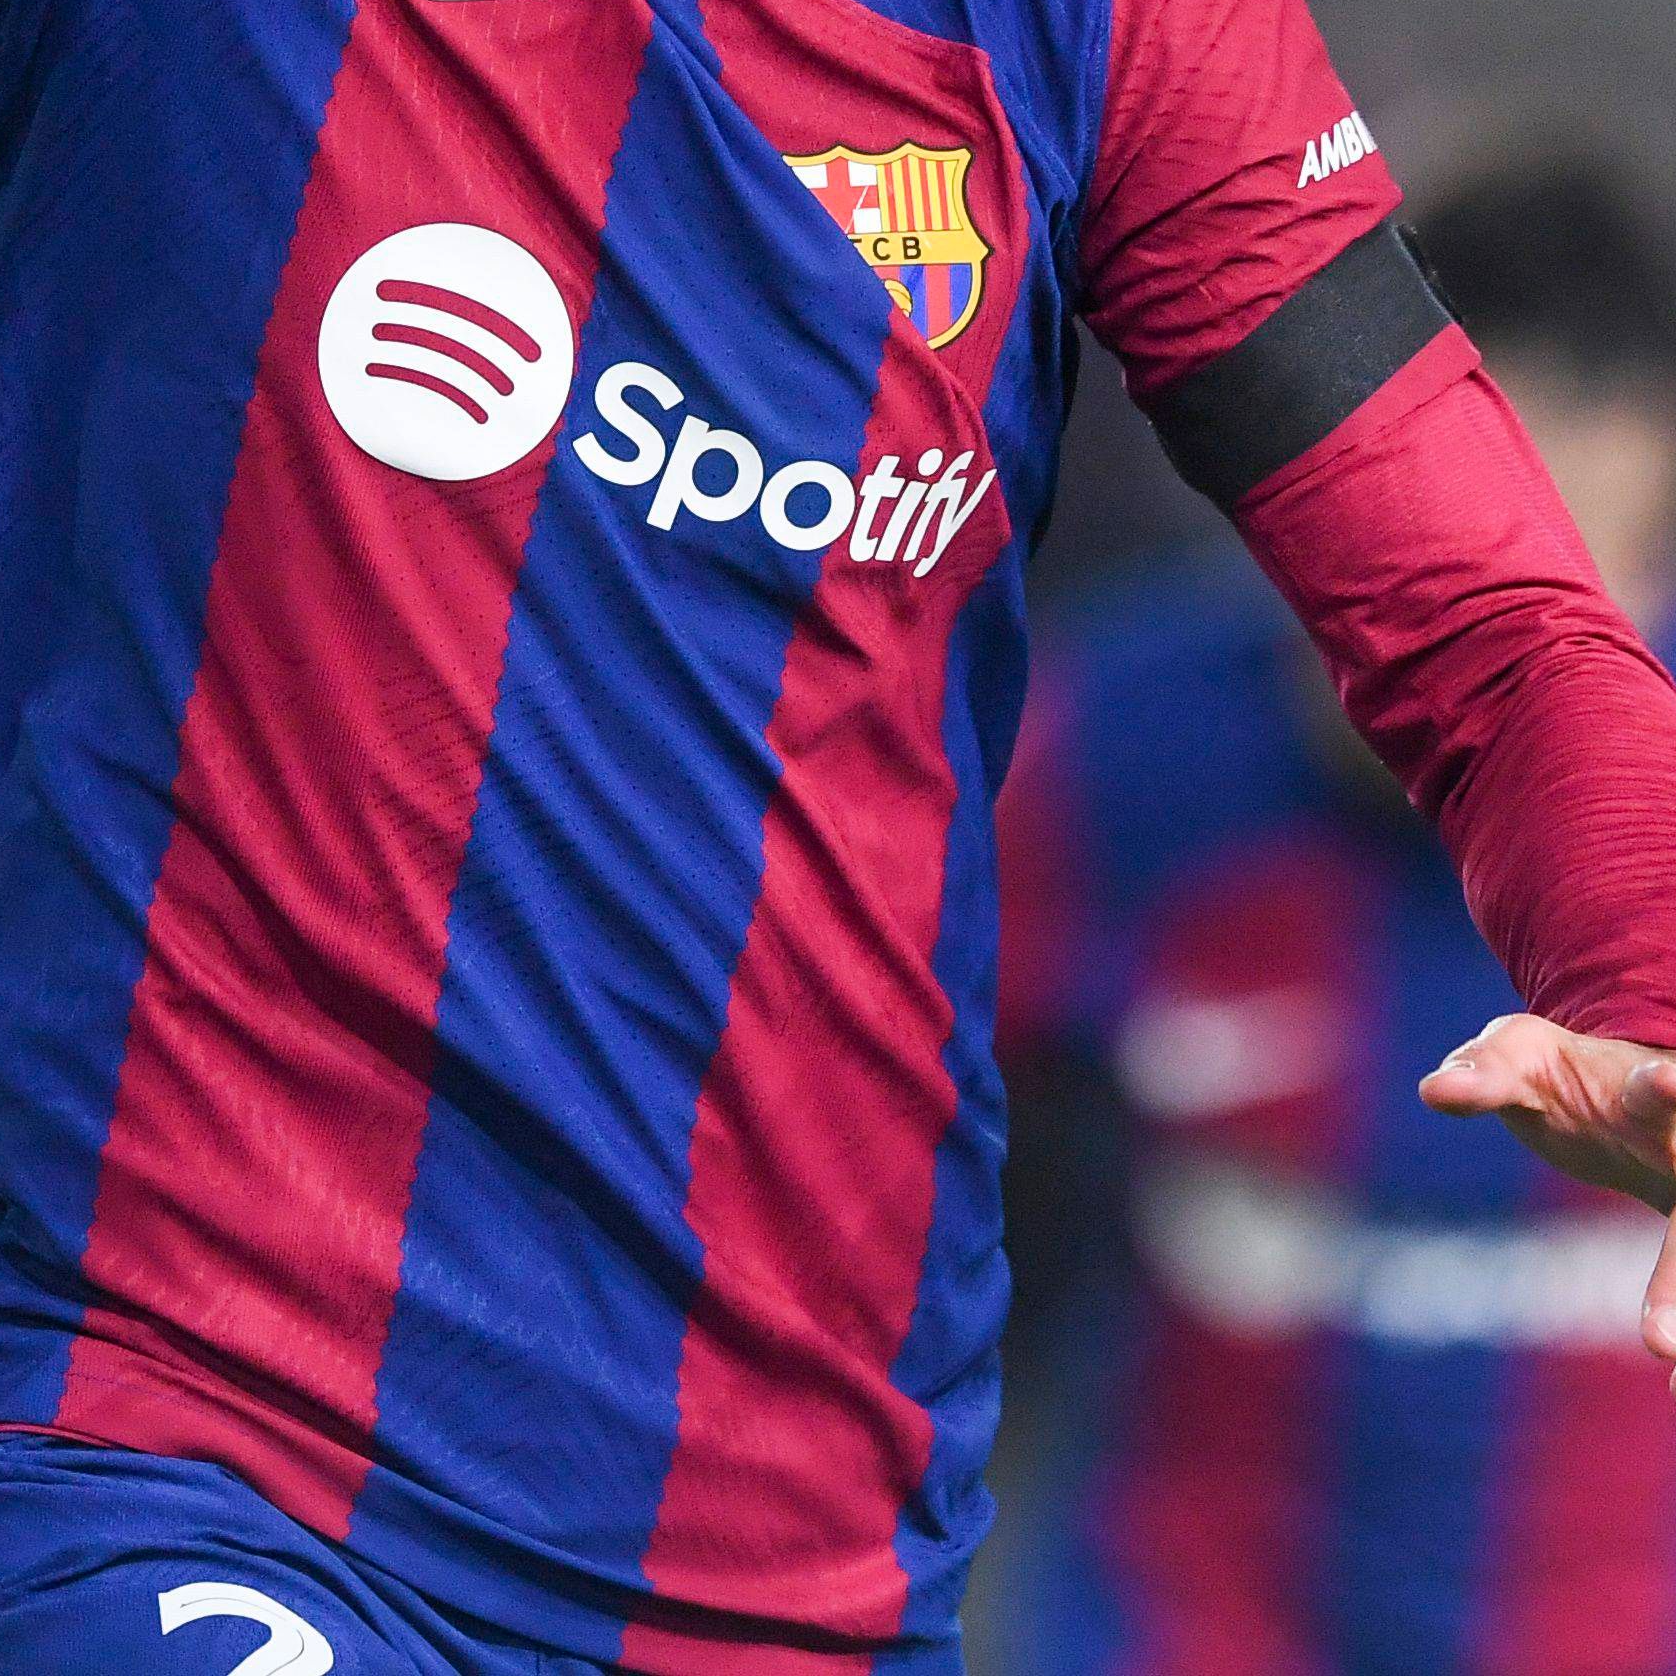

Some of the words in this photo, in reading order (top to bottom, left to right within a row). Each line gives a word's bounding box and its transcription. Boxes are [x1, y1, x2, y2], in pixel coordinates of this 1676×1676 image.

[1297, 110, 1379, 189] AMBI
[849, 236, 922, 261] CB
[572, 361, 998, 578] Spotify
